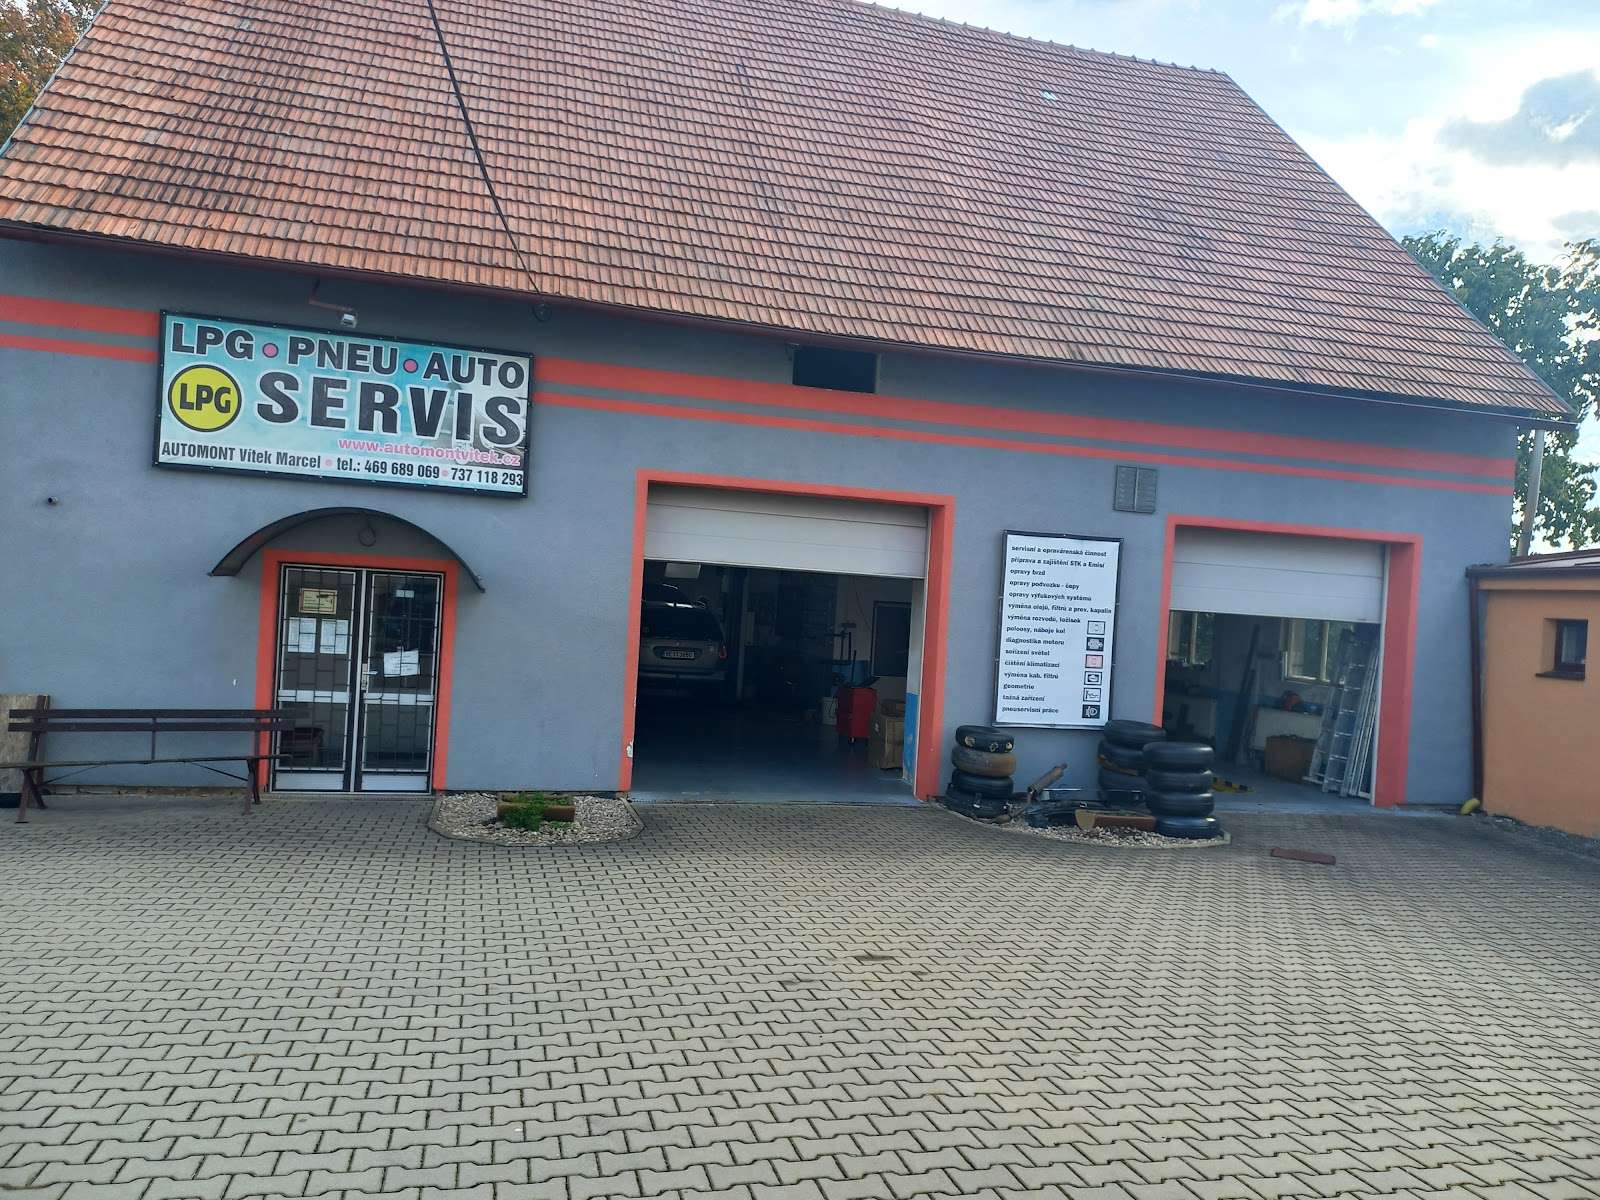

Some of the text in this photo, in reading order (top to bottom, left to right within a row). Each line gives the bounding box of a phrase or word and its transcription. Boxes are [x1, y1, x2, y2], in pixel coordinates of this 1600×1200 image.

[171, 322, 525, 389] LPG PNEU AUTO
[179, 383, 232, 413] LPG
[257, 371, 521, 447] SERVIS
[161, 441, 236, 461] AUTOMONT
[276, 451, 321, 469] Marcel
[337, 457, 361, 473] tel.:
[364, 460, 387, 475] 469
[391, 462, 414, 477] 689
[417, 464, 440, 479] 069
[451, 467, 473, 482] 737
[477, 470, 498, 484] 118
[502, 472, 523, 487] 293
[338, 439, 521, 467] www.automontvitek.cz
